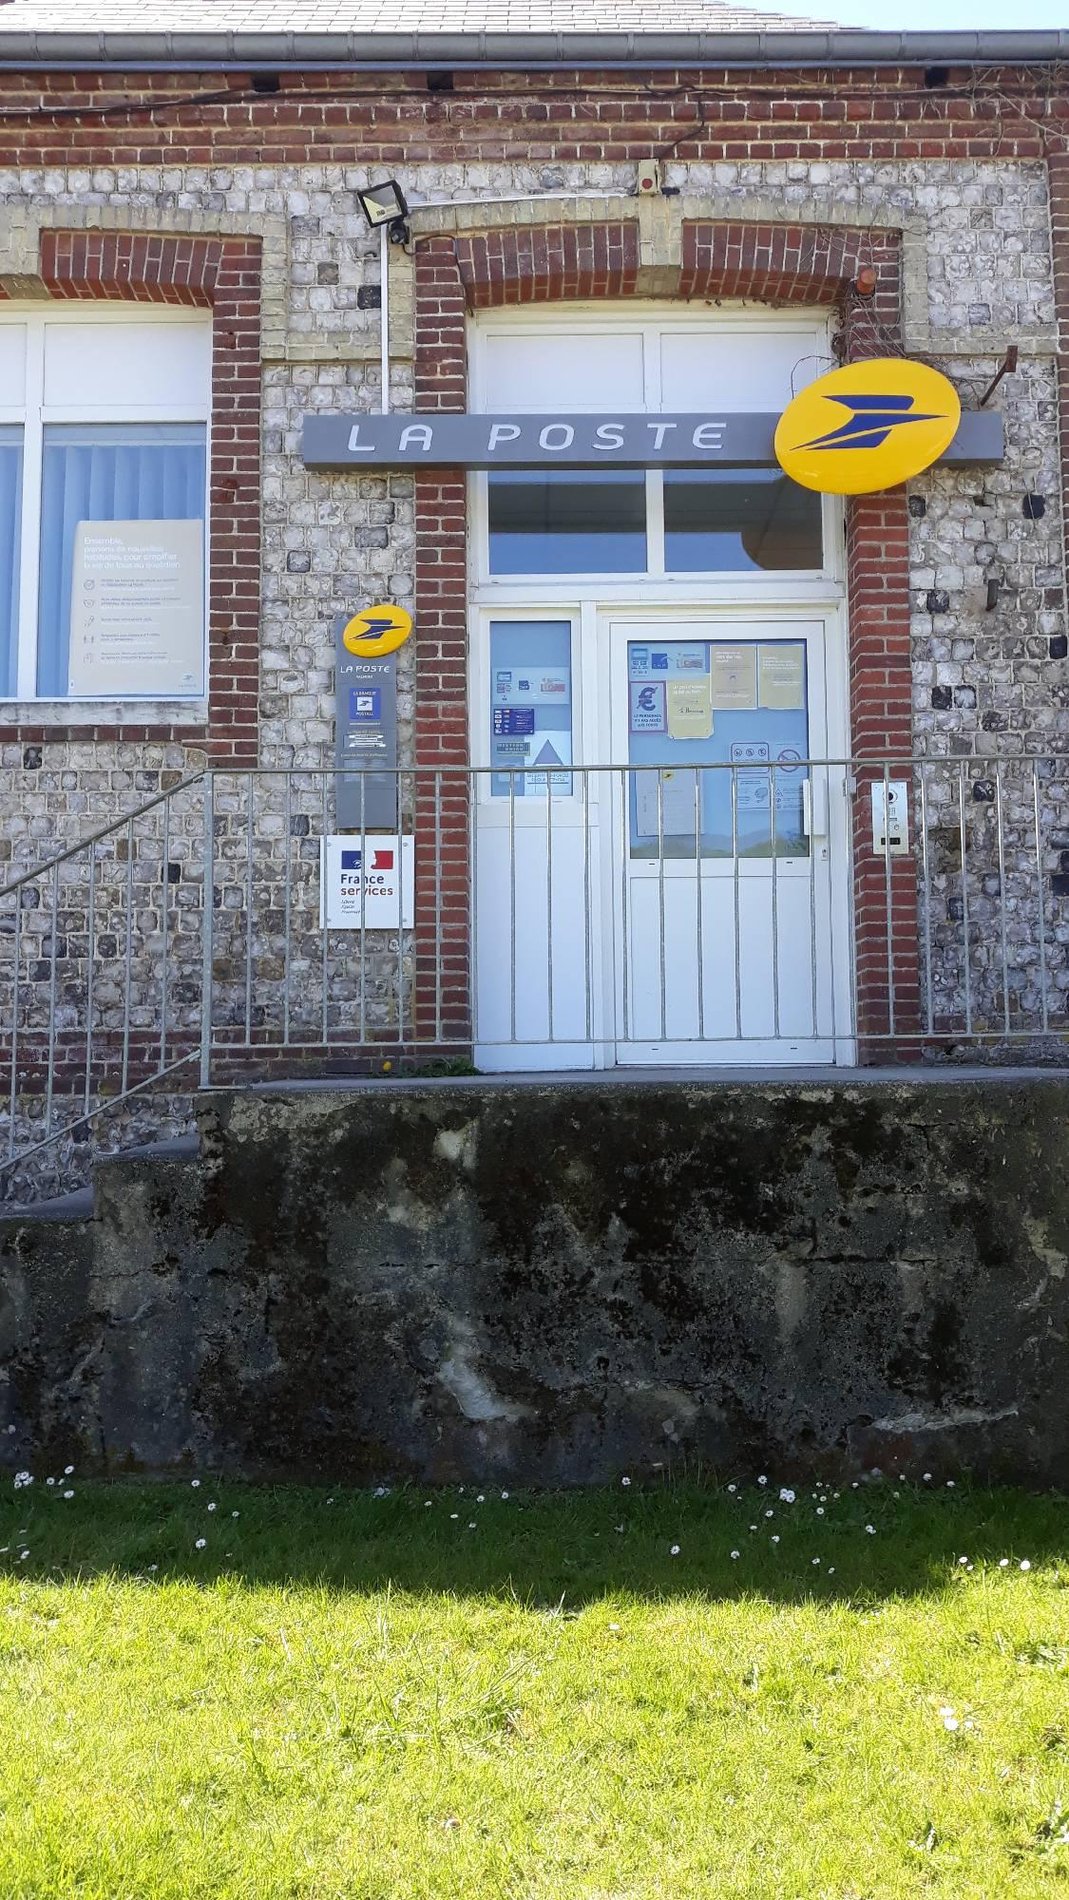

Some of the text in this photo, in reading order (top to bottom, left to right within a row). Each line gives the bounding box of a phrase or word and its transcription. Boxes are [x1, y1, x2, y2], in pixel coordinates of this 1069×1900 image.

[347, 422, 727, 452] LA POSTE
[356, 665, 392, 673] POSTE
